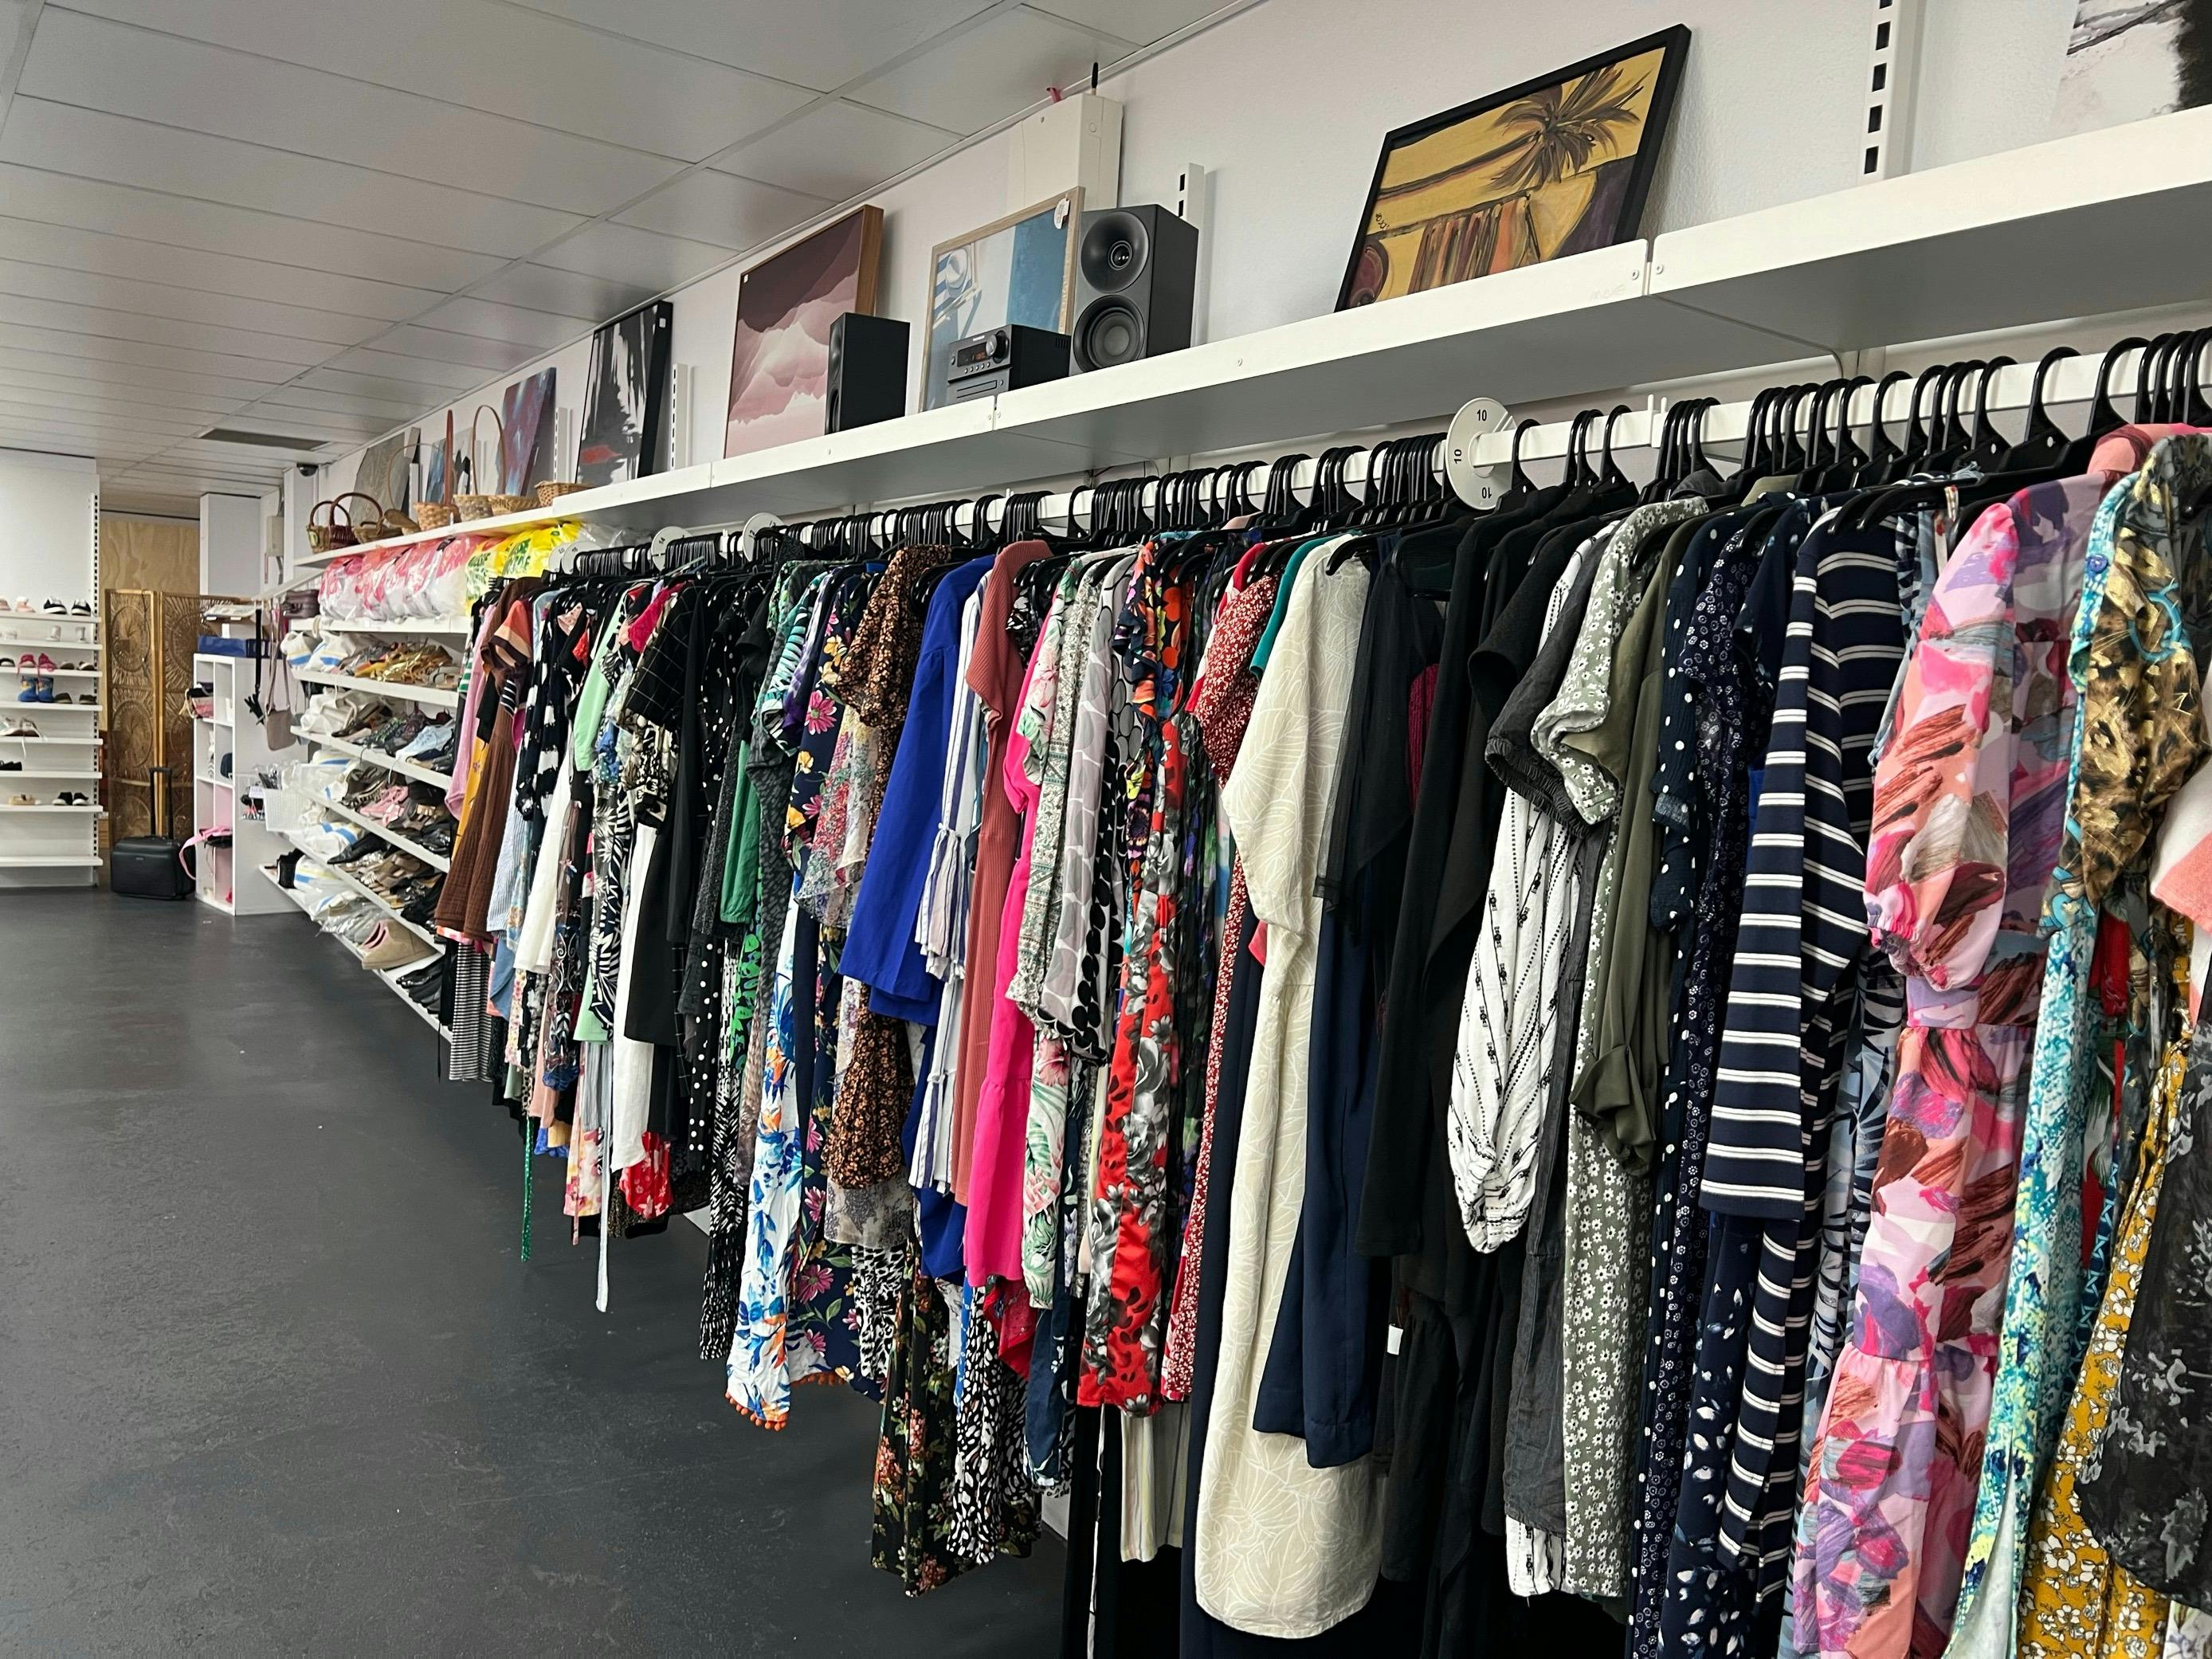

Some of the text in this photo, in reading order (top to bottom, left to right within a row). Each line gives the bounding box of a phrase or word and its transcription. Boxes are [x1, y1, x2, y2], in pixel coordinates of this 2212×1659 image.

[1477, 409, 1487, 422] 10
[1453, 449, 1462, 464] 10
[1482, 487, 1492, 499] 10
